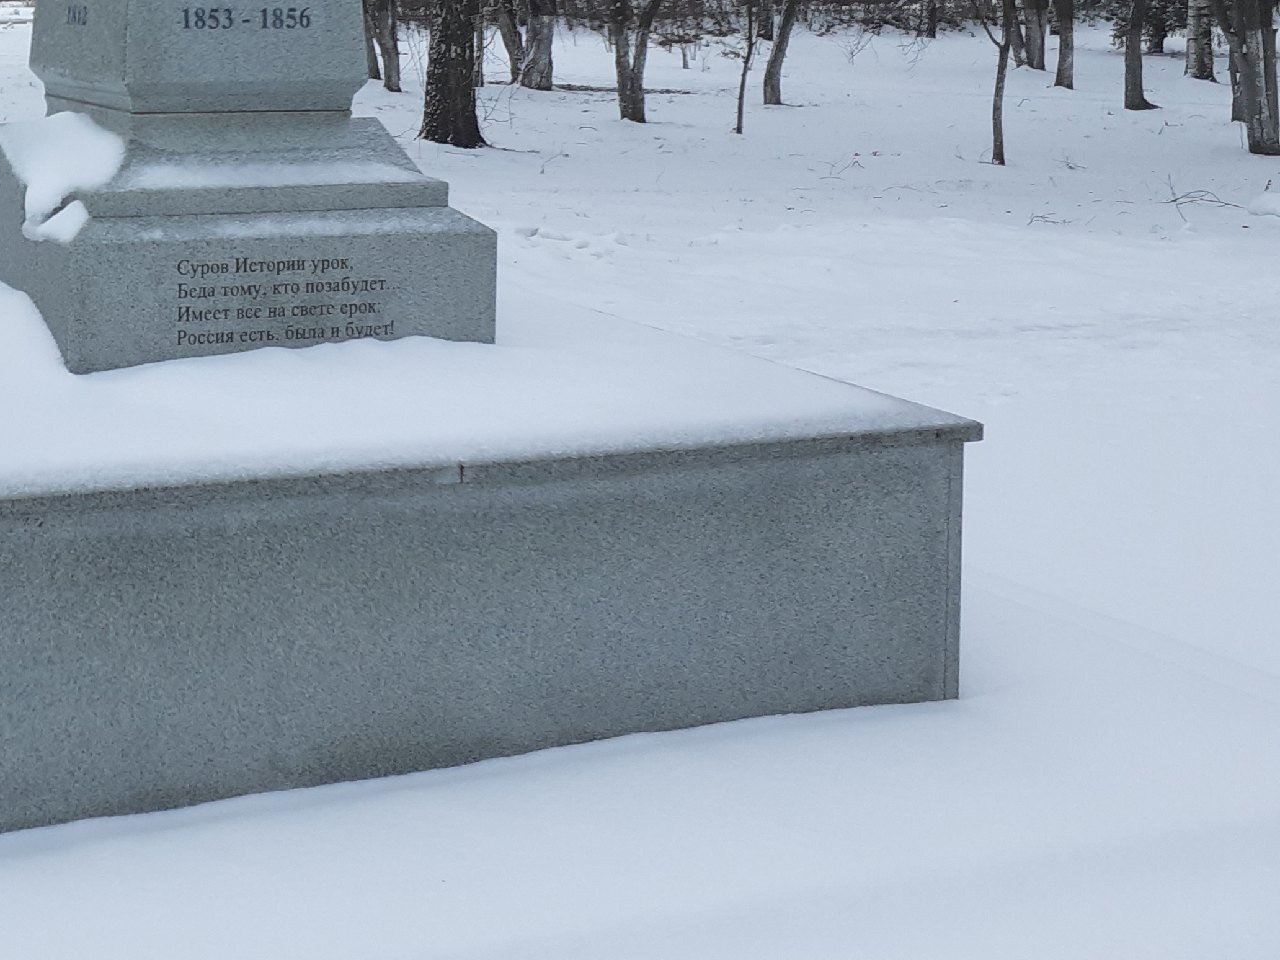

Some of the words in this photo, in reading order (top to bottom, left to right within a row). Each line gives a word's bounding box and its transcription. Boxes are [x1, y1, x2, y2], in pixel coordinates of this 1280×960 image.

[182, 7, 234, 30] 1853
[260, 7, 311, 30] 1856
[176, 259, 230, 279] Суров
[234, 257, 306, 275] Истории
[311, 257, 354, 274] урок,
[177, 283, 216, 299] Беда
[272, 283, 300, 295] кто
[177, 306, 230, 322] Имеет
[236, 307, 262, 320] все
[268, 306, 286, 319] на
[291, 304, 335, 317] свете
[177, 329, 234, 346] Россия
[285, 325, 325, 340] была
[330, 326, 340, 338] и
[345, 319, 395, 338] будет!
